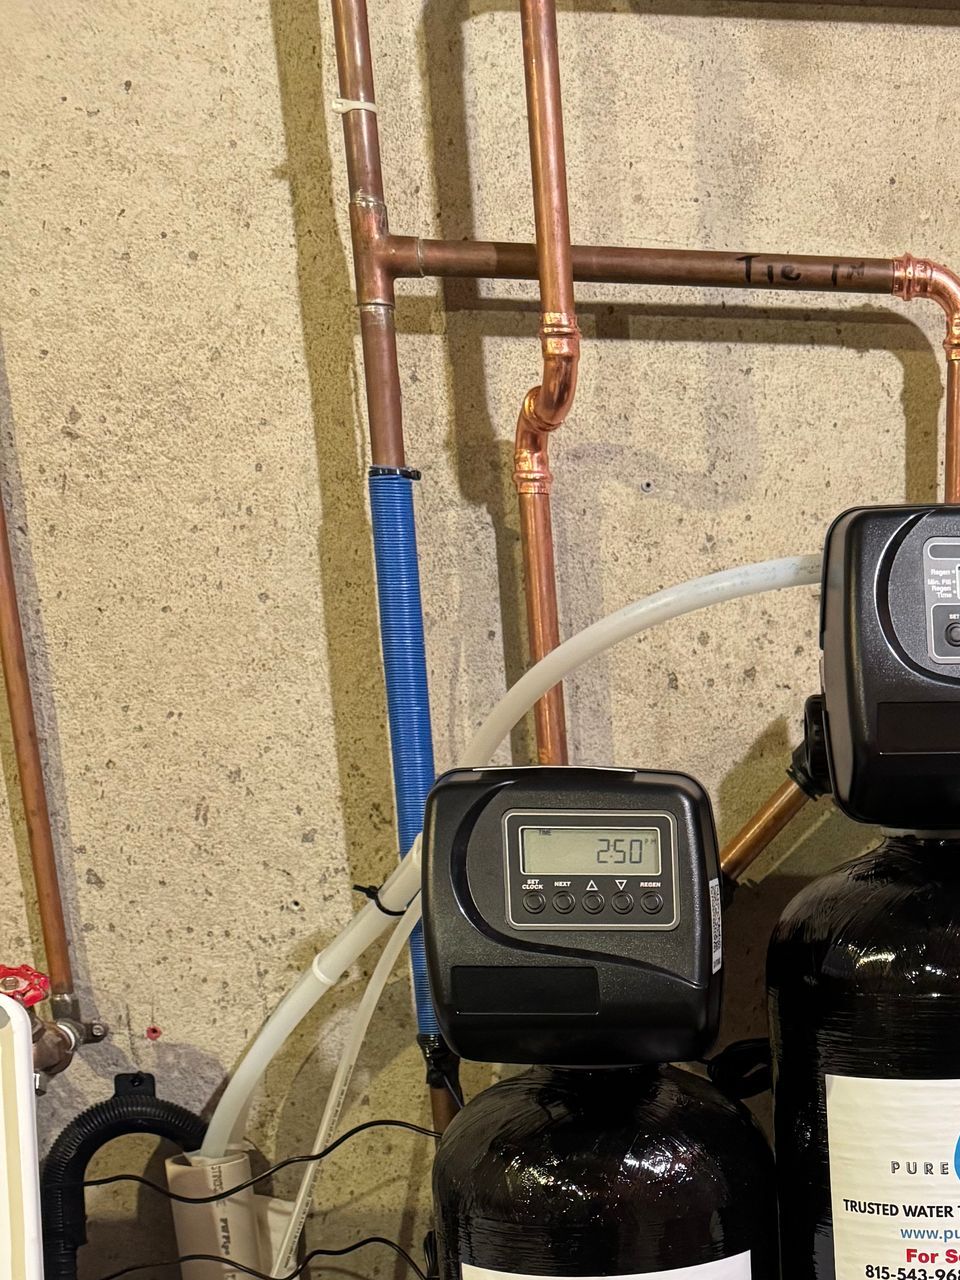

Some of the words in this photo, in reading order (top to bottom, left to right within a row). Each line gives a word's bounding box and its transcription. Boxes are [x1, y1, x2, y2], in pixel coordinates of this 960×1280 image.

[890, 1160, 950, 1175] PURE
[842, 1198, 899, 1217] TRUSTED
[902, 1204, 954, 1218] WATER
[906, 1249, 940, 1264] For
